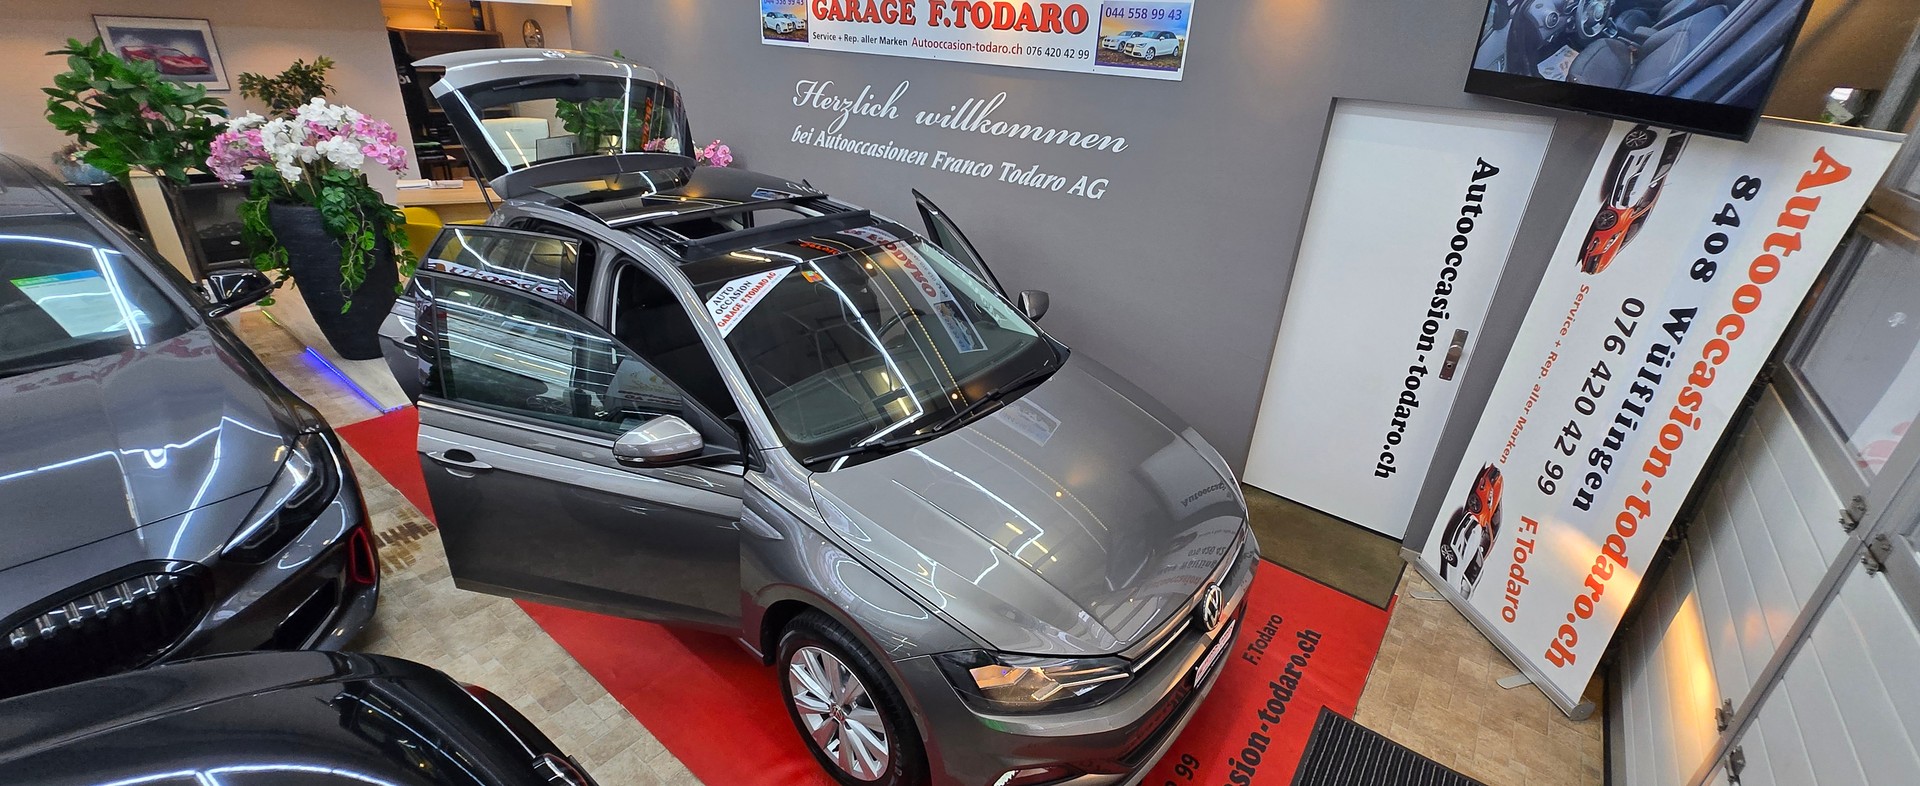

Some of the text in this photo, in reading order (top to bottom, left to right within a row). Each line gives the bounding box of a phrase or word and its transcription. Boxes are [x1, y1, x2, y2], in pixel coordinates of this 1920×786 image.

[811, 0, 1090, 35] GARAGE F.TODARO
[1105, 7, 1182, 21] 044 558 99 43
[812, 31, 837, 42] Service
[843, 33, 859, 44] Rep.
[861, 35, 878, 45] aller
[879, 36, 908, 47] Marken
[911, 37, 1023, 56] Autooccasion-todaro.ch
[1026, 46, 1042, 57] 076
[1044, 47, 1062, 58] 420
[1064, 48, 1076, 59] 42
[1078, 49, 1090, 60] 99
[792, 79, 1129, 153] Herzlich willkommen
[791, 125, 1110, 200] bei Autooccasionen Franco Todaro AG
[712, 286, 735, 306] AUTO
[715, 280, 753, 315] OCCASION
[717, 302, 744, 328] GARAGE
[740, 278, 769, 304] F.TODARO
[767, 271, 777, 281] AG
[1374, 156, 1500, 479] Autooccasion-todaro.ch
[1559, 283, 1590, 337] Service
[1537, 351, 1559, 380] Rep.
[1572, 174, 1763, 512] 8408 Wülflingen
[1519, 382, 1542, 415] aller
[1537, 297, 1646, 496] 076 420 42 99
[1545, 146, 1853, 668] Autooccasion-todaro.ch
[1499, 416, 1528, 464] Marken
[1502, 515, 1539, 623] F.Todaro
[1242, 614, 1283, 666] F.Todaro
[1223, 628, 1322, 786] sion-todaro.ch
[1174, 753, 1200, 781] 99
